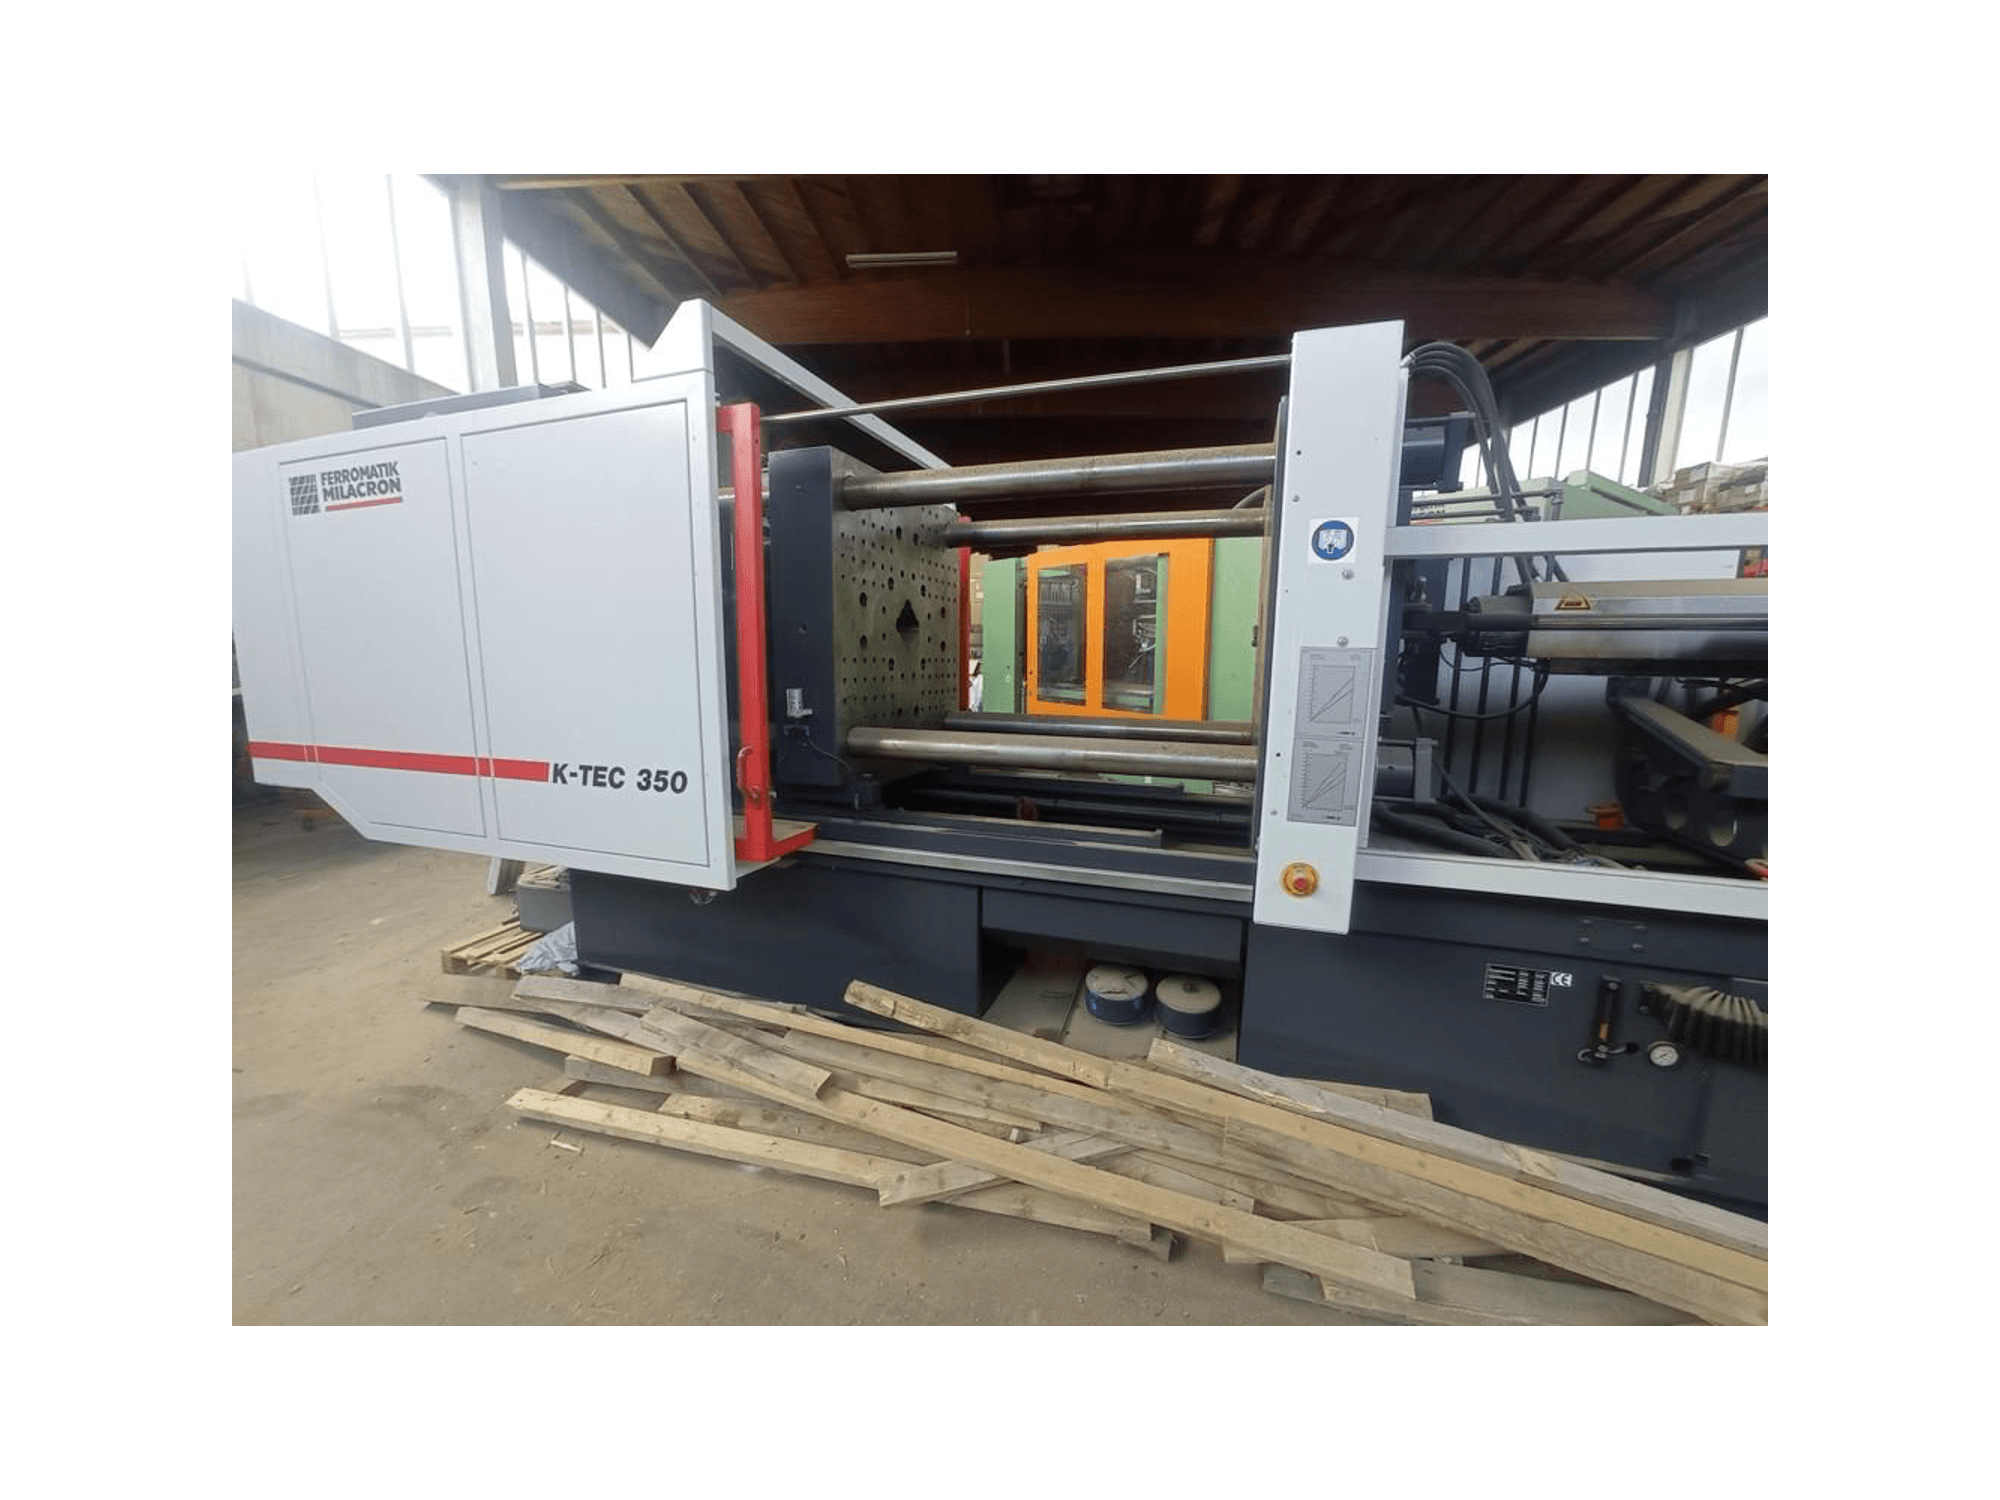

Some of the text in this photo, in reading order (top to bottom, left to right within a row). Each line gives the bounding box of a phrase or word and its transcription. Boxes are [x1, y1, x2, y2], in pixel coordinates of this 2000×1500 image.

[320, 461, 400, 486] FERROMATIK
[322, 478, 402, 502] MILACRON
[552, 763, 688, 794] K-TEC 350
